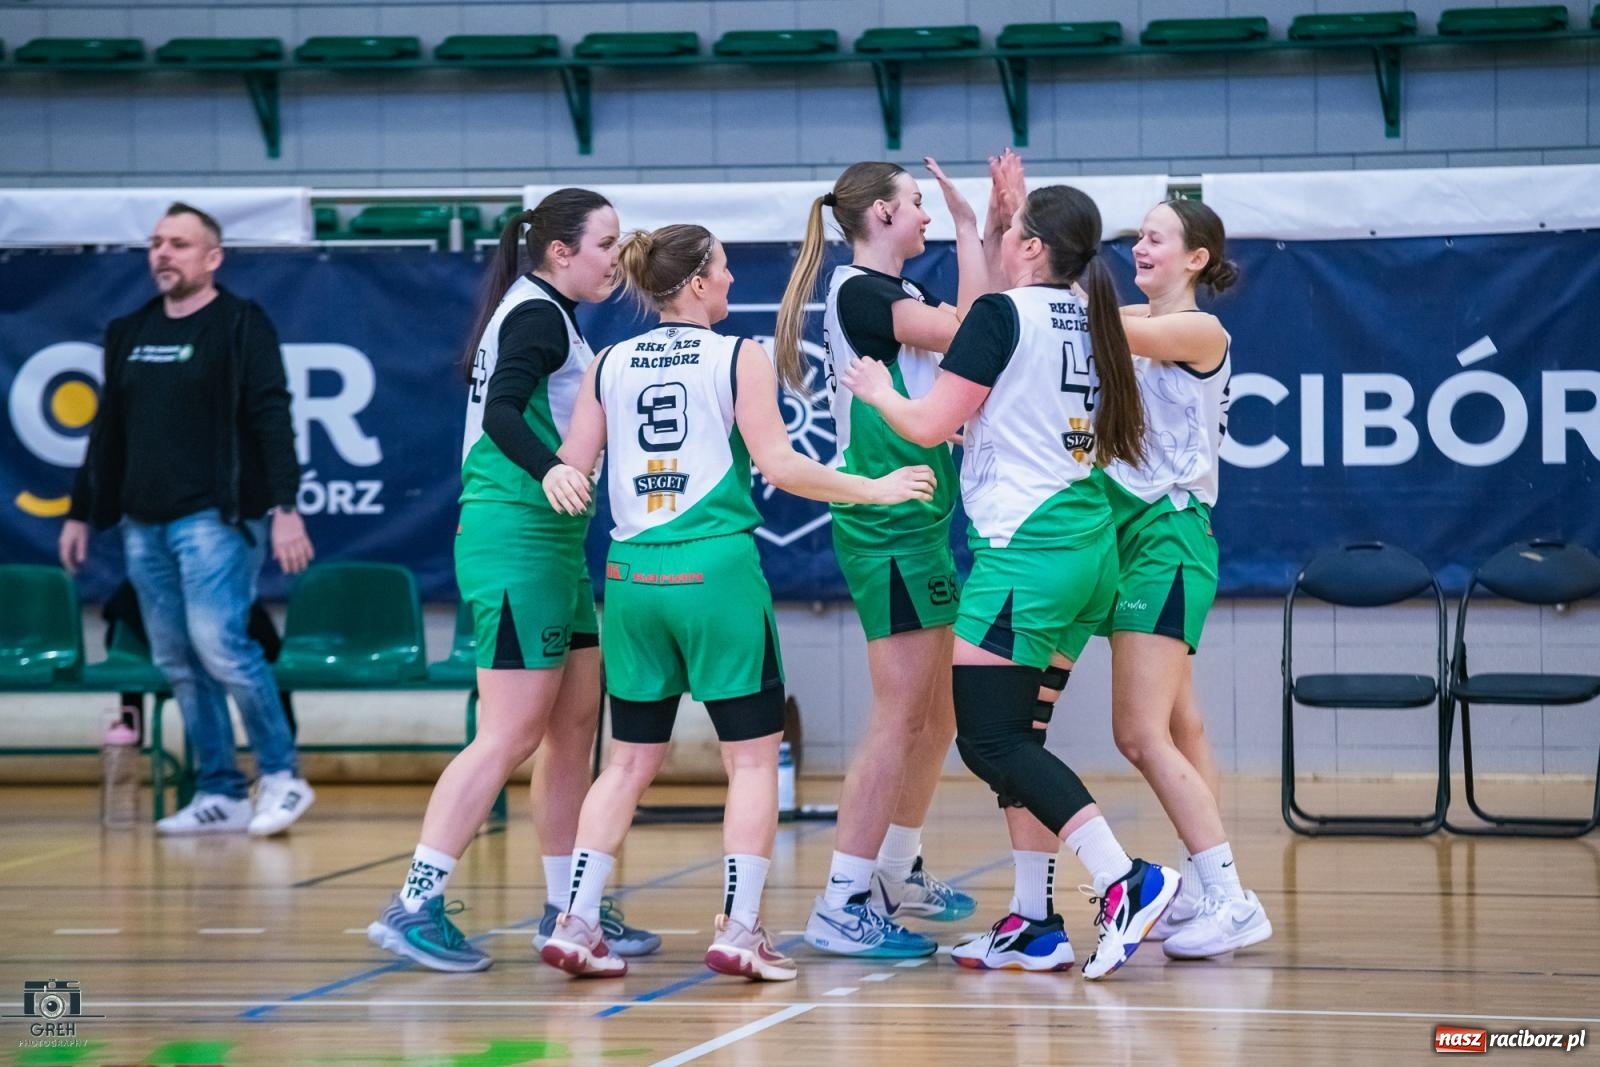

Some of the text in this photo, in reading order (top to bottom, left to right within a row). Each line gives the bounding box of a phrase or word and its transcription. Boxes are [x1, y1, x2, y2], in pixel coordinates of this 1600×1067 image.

[1048, 303, 1076, 314] RKK
[635, 339, 701, 352] RKK AZS
[630, 352, 700, 368] RACIBÓRZ
[637, 381, 688, 453] 3
[638, 476, 686, 492] SEGET
